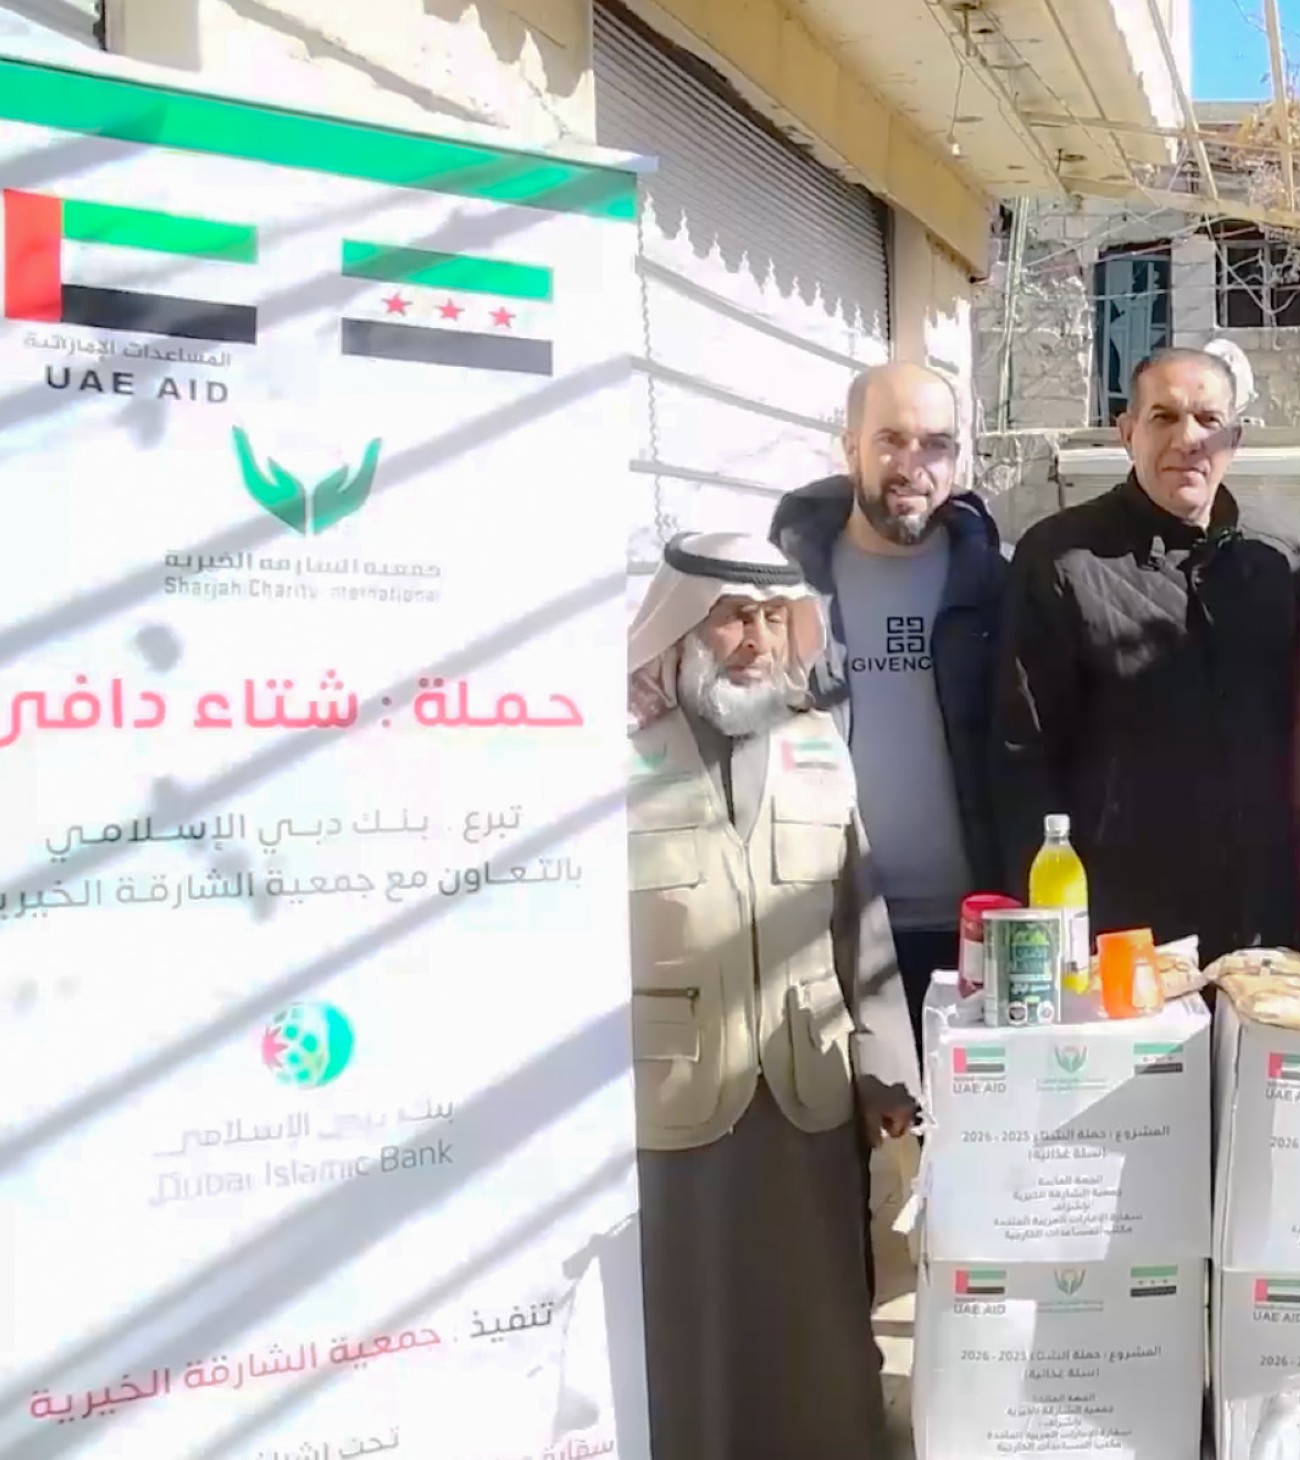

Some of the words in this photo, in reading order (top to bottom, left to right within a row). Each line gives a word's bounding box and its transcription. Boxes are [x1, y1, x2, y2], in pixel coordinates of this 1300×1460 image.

[46, 365, 134, 395] UAE
[158, 377, 229, 404] AID
[164, 575, 242, 600] Sharjah
[193, 668, 358, 729] شتاء
[413, 677, 584, 728] حملة
[46, 812, 245, 863] الإسلامي
[258, 813, 342, 854] دبي
[352, 807, 429, 841] بنك
[463, 805, 522, 843] تبرع
[116, 868, 253, 910] الشارقة
[266, 869, 375, 905] جمعية
[385, 869, 428, 902] مع
[438, 856, 582, 896] بالتعاون
[953, 1083, 979, 1094] UAE
[982, 1083, 1007, 1094] AID
[1265, 1088, 1293, 1101] UAE
[265, 1155, 370, 1188] Islamic
[380, 1139, 453, 1173] Bank
[470, 1301, 554, 1343] تنفيذ
[953, 1304, 979, 1314] UAE
[983, 1304, 1006, 1314] AID
[1253, 1312, 1279, 1322] UAE
[183, 1342, 317, 1390] الشارقة
[329, 1328, 441, 1370] جمعية
[1260, 1355, 1288, 1368] 2026
[30, 1367, 171, 1424] الخيرية
